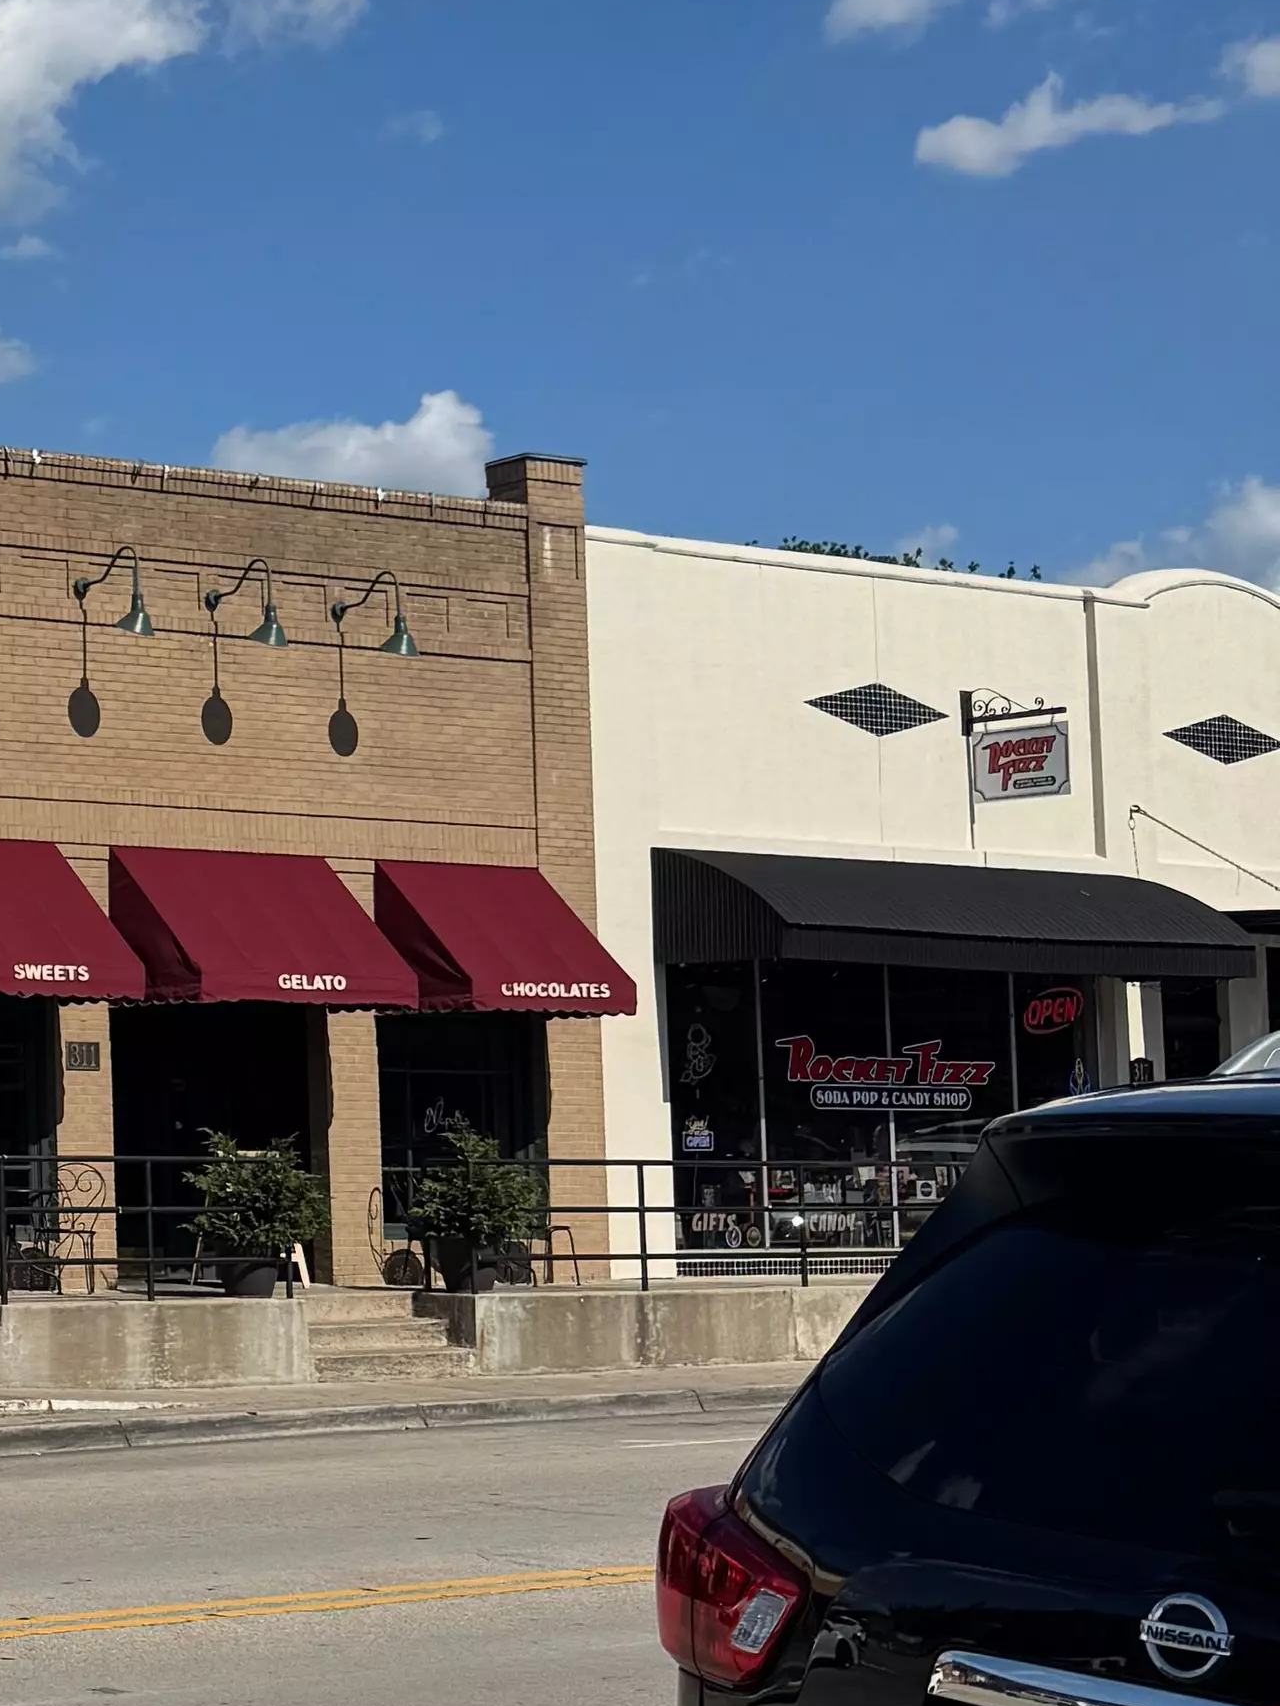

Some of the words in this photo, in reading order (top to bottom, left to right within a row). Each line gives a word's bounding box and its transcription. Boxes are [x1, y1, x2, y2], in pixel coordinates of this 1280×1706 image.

[981, 735, 1057, 775] ROCKET
[998, 755, 1049, 792] FIZZ
[13, 963, 90, 982] SWEETS
[277, 973, 347, 991] GELATO
[500, 981, 612, 999] CHOCOLATES
[1027, 994, 1078, 1027] OPEN
[70, 1043, 97, 1066] 311
[775, 1034, 913, 1083] ROCKET
[902, 1038, 996, 1086] FIZZ
[815, 1089, 851, 1105] SODA
[852, 1090, 878, 1105] POP
[881, 1090, 890, 1105] &
[892, 1089, 931, 1106] CANDY
[933, 1089, 968, 1106] SHOP
[692, 1213, 737, 1232] GIFTS
[809, 1212, 856, 1232] CANDY
[1145, 1624, 1225, 1652] NISSAN
